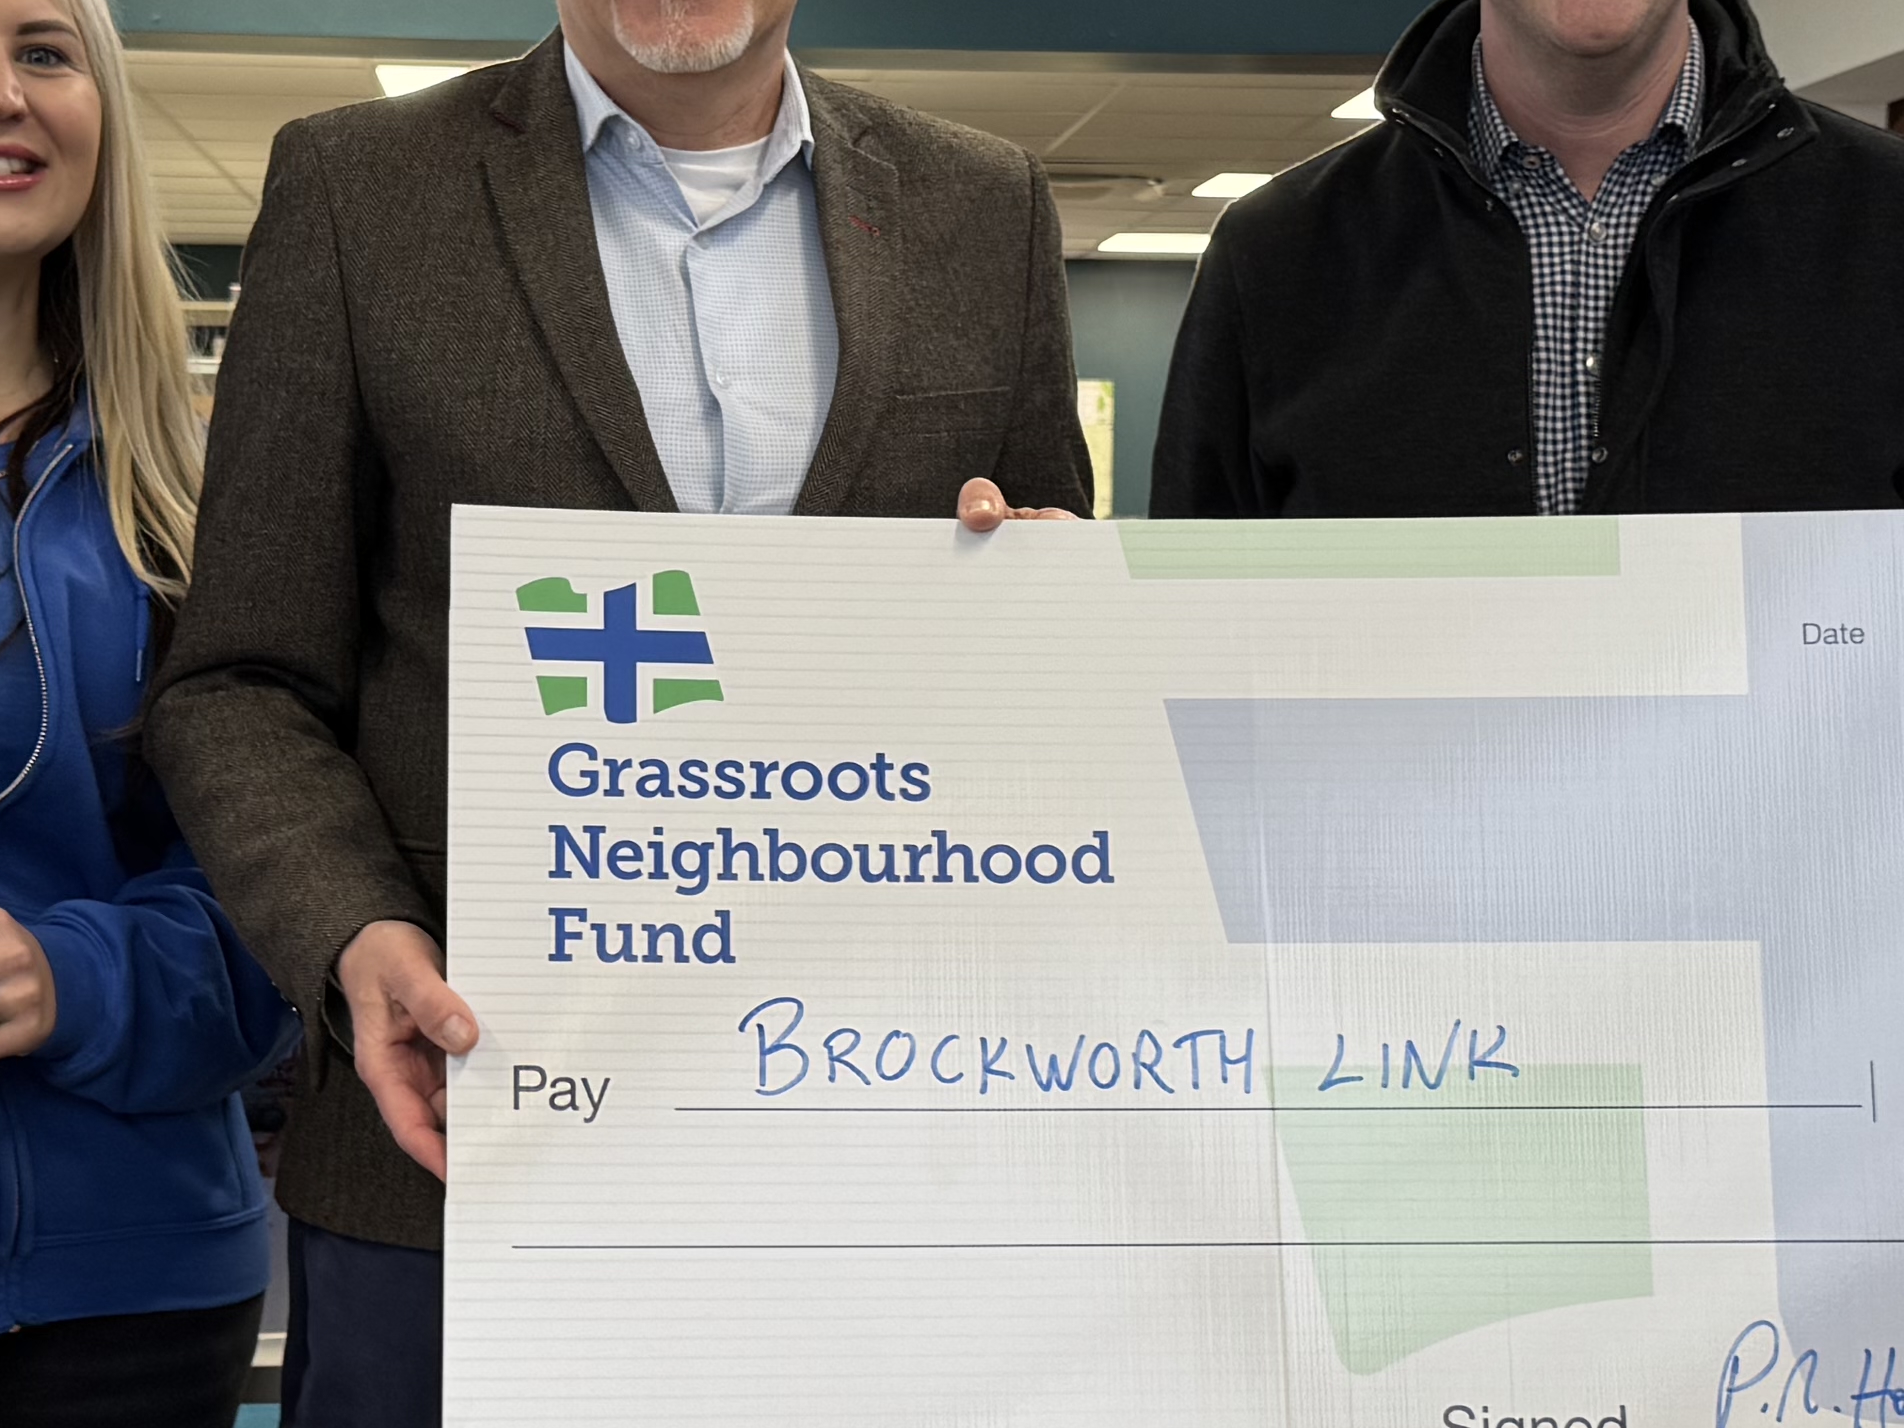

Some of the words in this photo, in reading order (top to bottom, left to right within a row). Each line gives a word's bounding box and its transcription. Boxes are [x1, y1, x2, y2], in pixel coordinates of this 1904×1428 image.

[1801, 619, 1866, 648] Date
[547, 741, 932, 802] Grassroots
[547, 824, 1115, 896] Neighbourhood
[547, 906, 737, 965] Fund
[738, 996, 1256, 1098] BROCKWORTH
[1317, 1017, 1522, 1093] LINK
[510, 1063, 611, 1124] Pay
